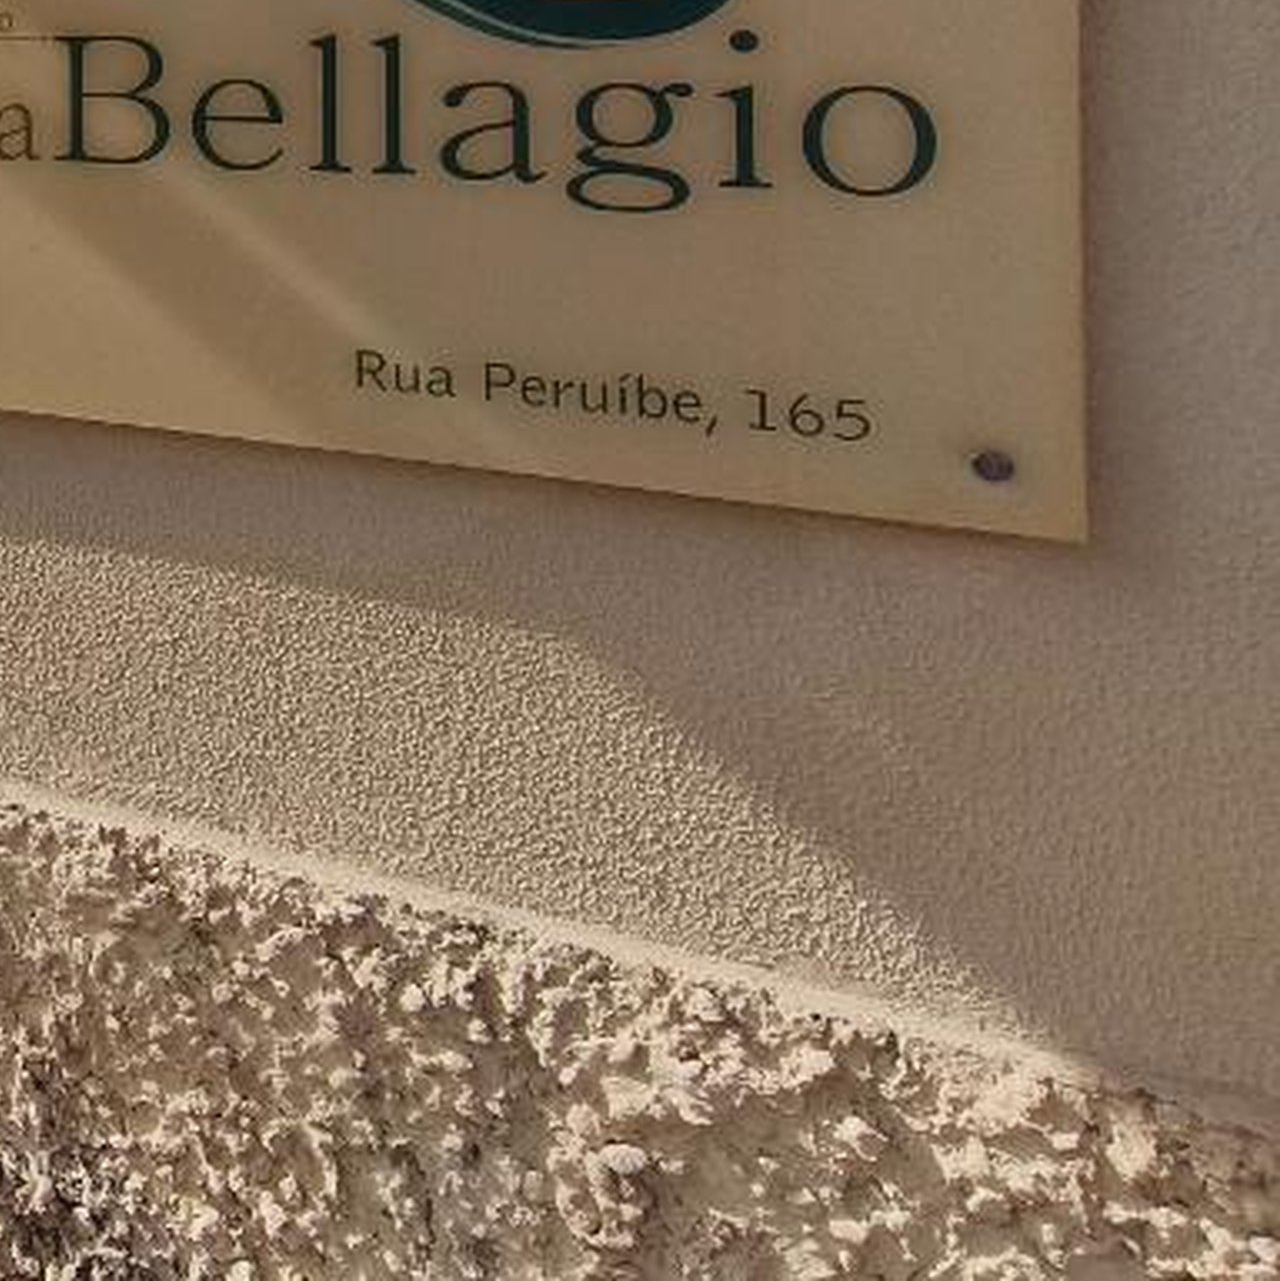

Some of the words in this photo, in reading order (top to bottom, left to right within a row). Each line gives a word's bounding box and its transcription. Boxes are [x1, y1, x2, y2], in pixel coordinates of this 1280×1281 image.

[53, 29, 938, 213] Bellagio
[354, 349, 456, 399] Rua
[484, 361, 718, 437] Peruíbe,
[745, 388, 872, 442] 165
